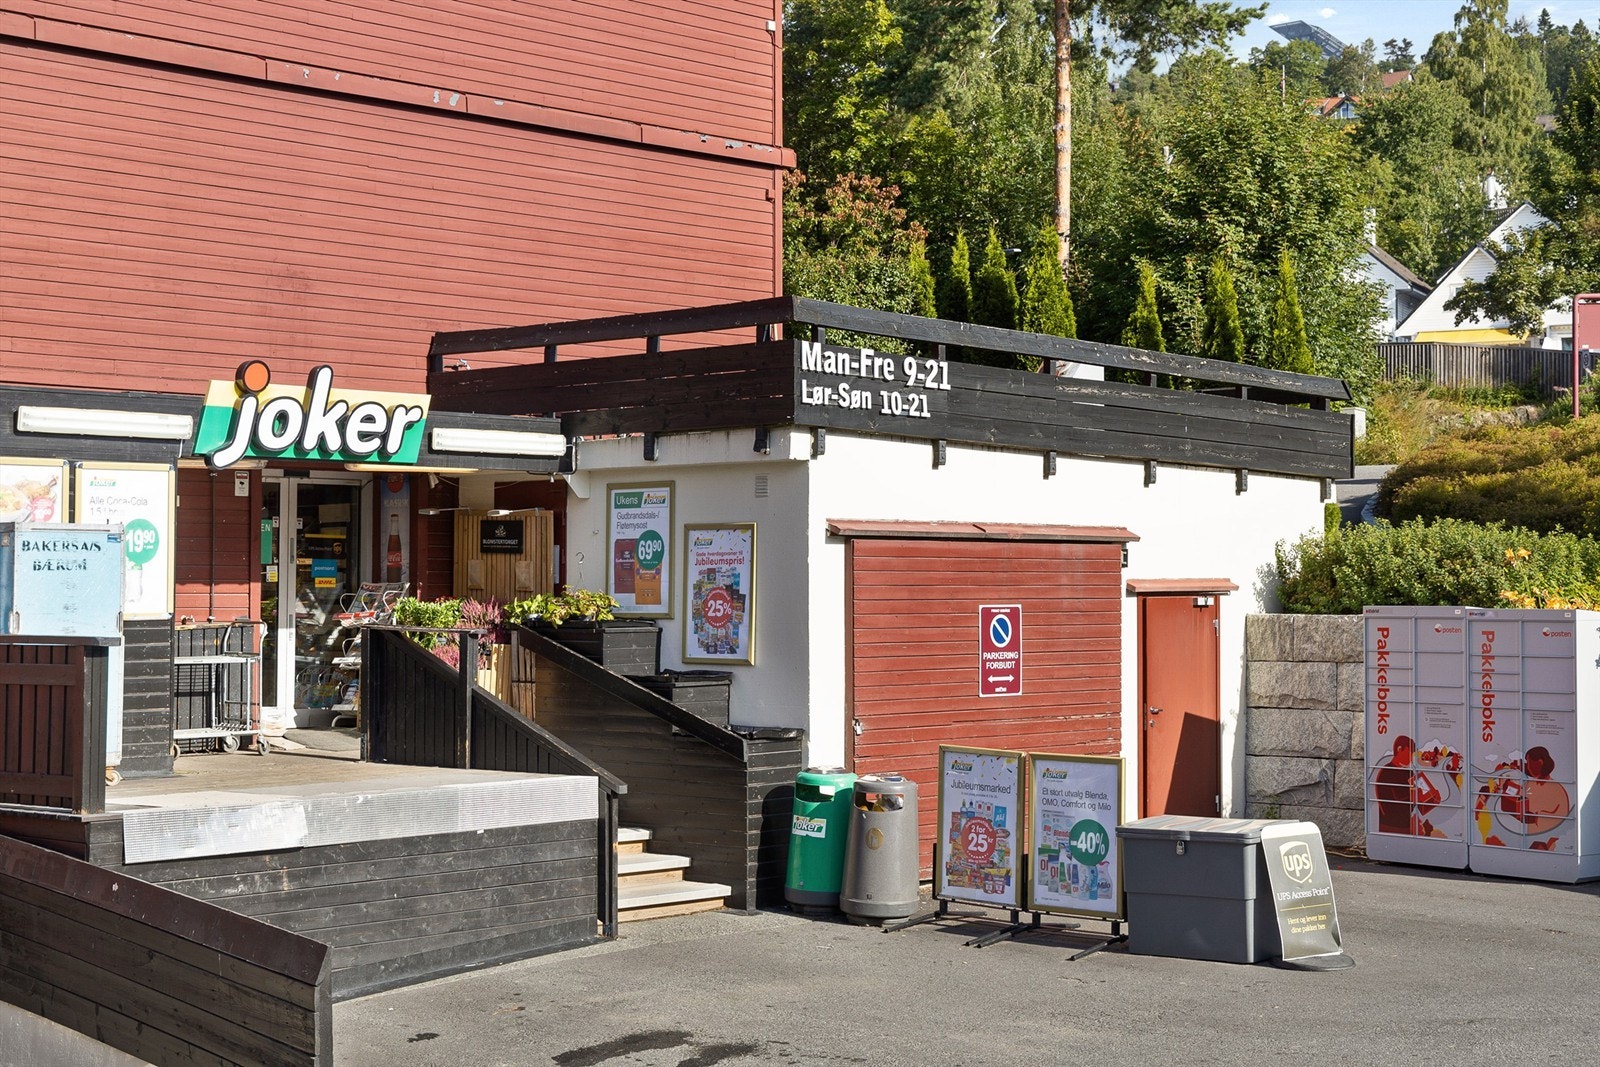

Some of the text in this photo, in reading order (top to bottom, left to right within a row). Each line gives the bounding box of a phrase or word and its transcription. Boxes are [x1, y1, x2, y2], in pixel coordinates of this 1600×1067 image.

[802, 340, 951, 391] Man-Fre 9-21
[802, 379, 931, 418] Lør-Søn 10-21
[204, 360, 424, 470] joker
[616, 495, 639, 505] Ukens
[695, 555, 745, 567] Jubileumspris!
[705, 600, 732, 618] -25%
[1442, 626, 1462, 634] posten
[1550, 630, 1572, 638] posten
[983, 651, 1019, 660] PARKERING
[986, 661, 1016, 670] FORBUDT
[951, 779, 1012, 795] Jubileumsmarked
[1042, 787, 1049, 795] Et
[1050, 789, 1064, 797] stort
[1064, 790, 1084, 800] utvalg
[1060, 799, 1086, 809] Comfort
[1087, 802, 1097, 812] og
[1097, 802, 1112, 811] Milo
[971, 825, 986, 834] 2 for
[968, 833, 988, 853] 25
[1070, 831, 1106, 856] -40%
[1283, 853, 1311, 877] ups
[1277, 891, 1292, 901] UPS
[1291, 889, 1313, 900] Access
[1300, 917, 1307, 925] og
[1306, 915, 1318, 923] lever
[1302, 925, 1317, 934] pakker
[1317, 923, 1326, 931] her
